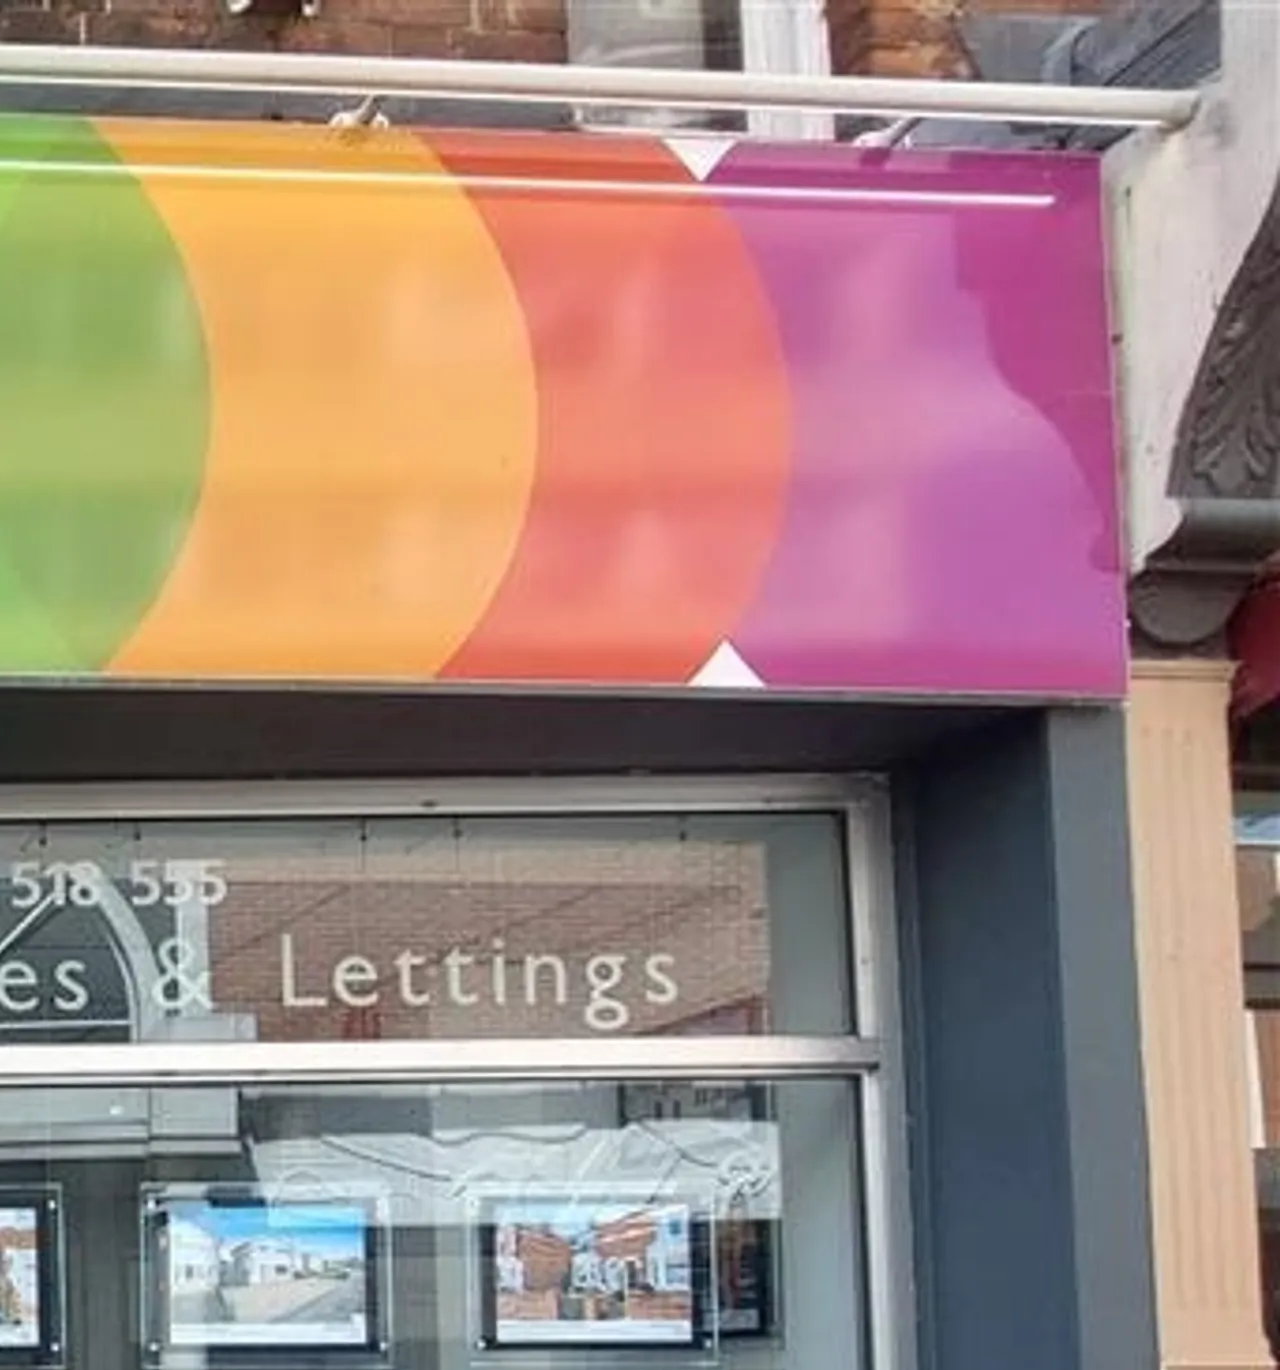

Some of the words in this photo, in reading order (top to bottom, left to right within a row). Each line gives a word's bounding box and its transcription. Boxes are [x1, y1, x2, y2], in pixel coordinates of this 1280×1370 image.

[11, 861, 101, 908] 518
[131, 858, 228, 906] 555
[152, 937, 214, 1011] &
[280, 933, 679, 1030] Lettings
